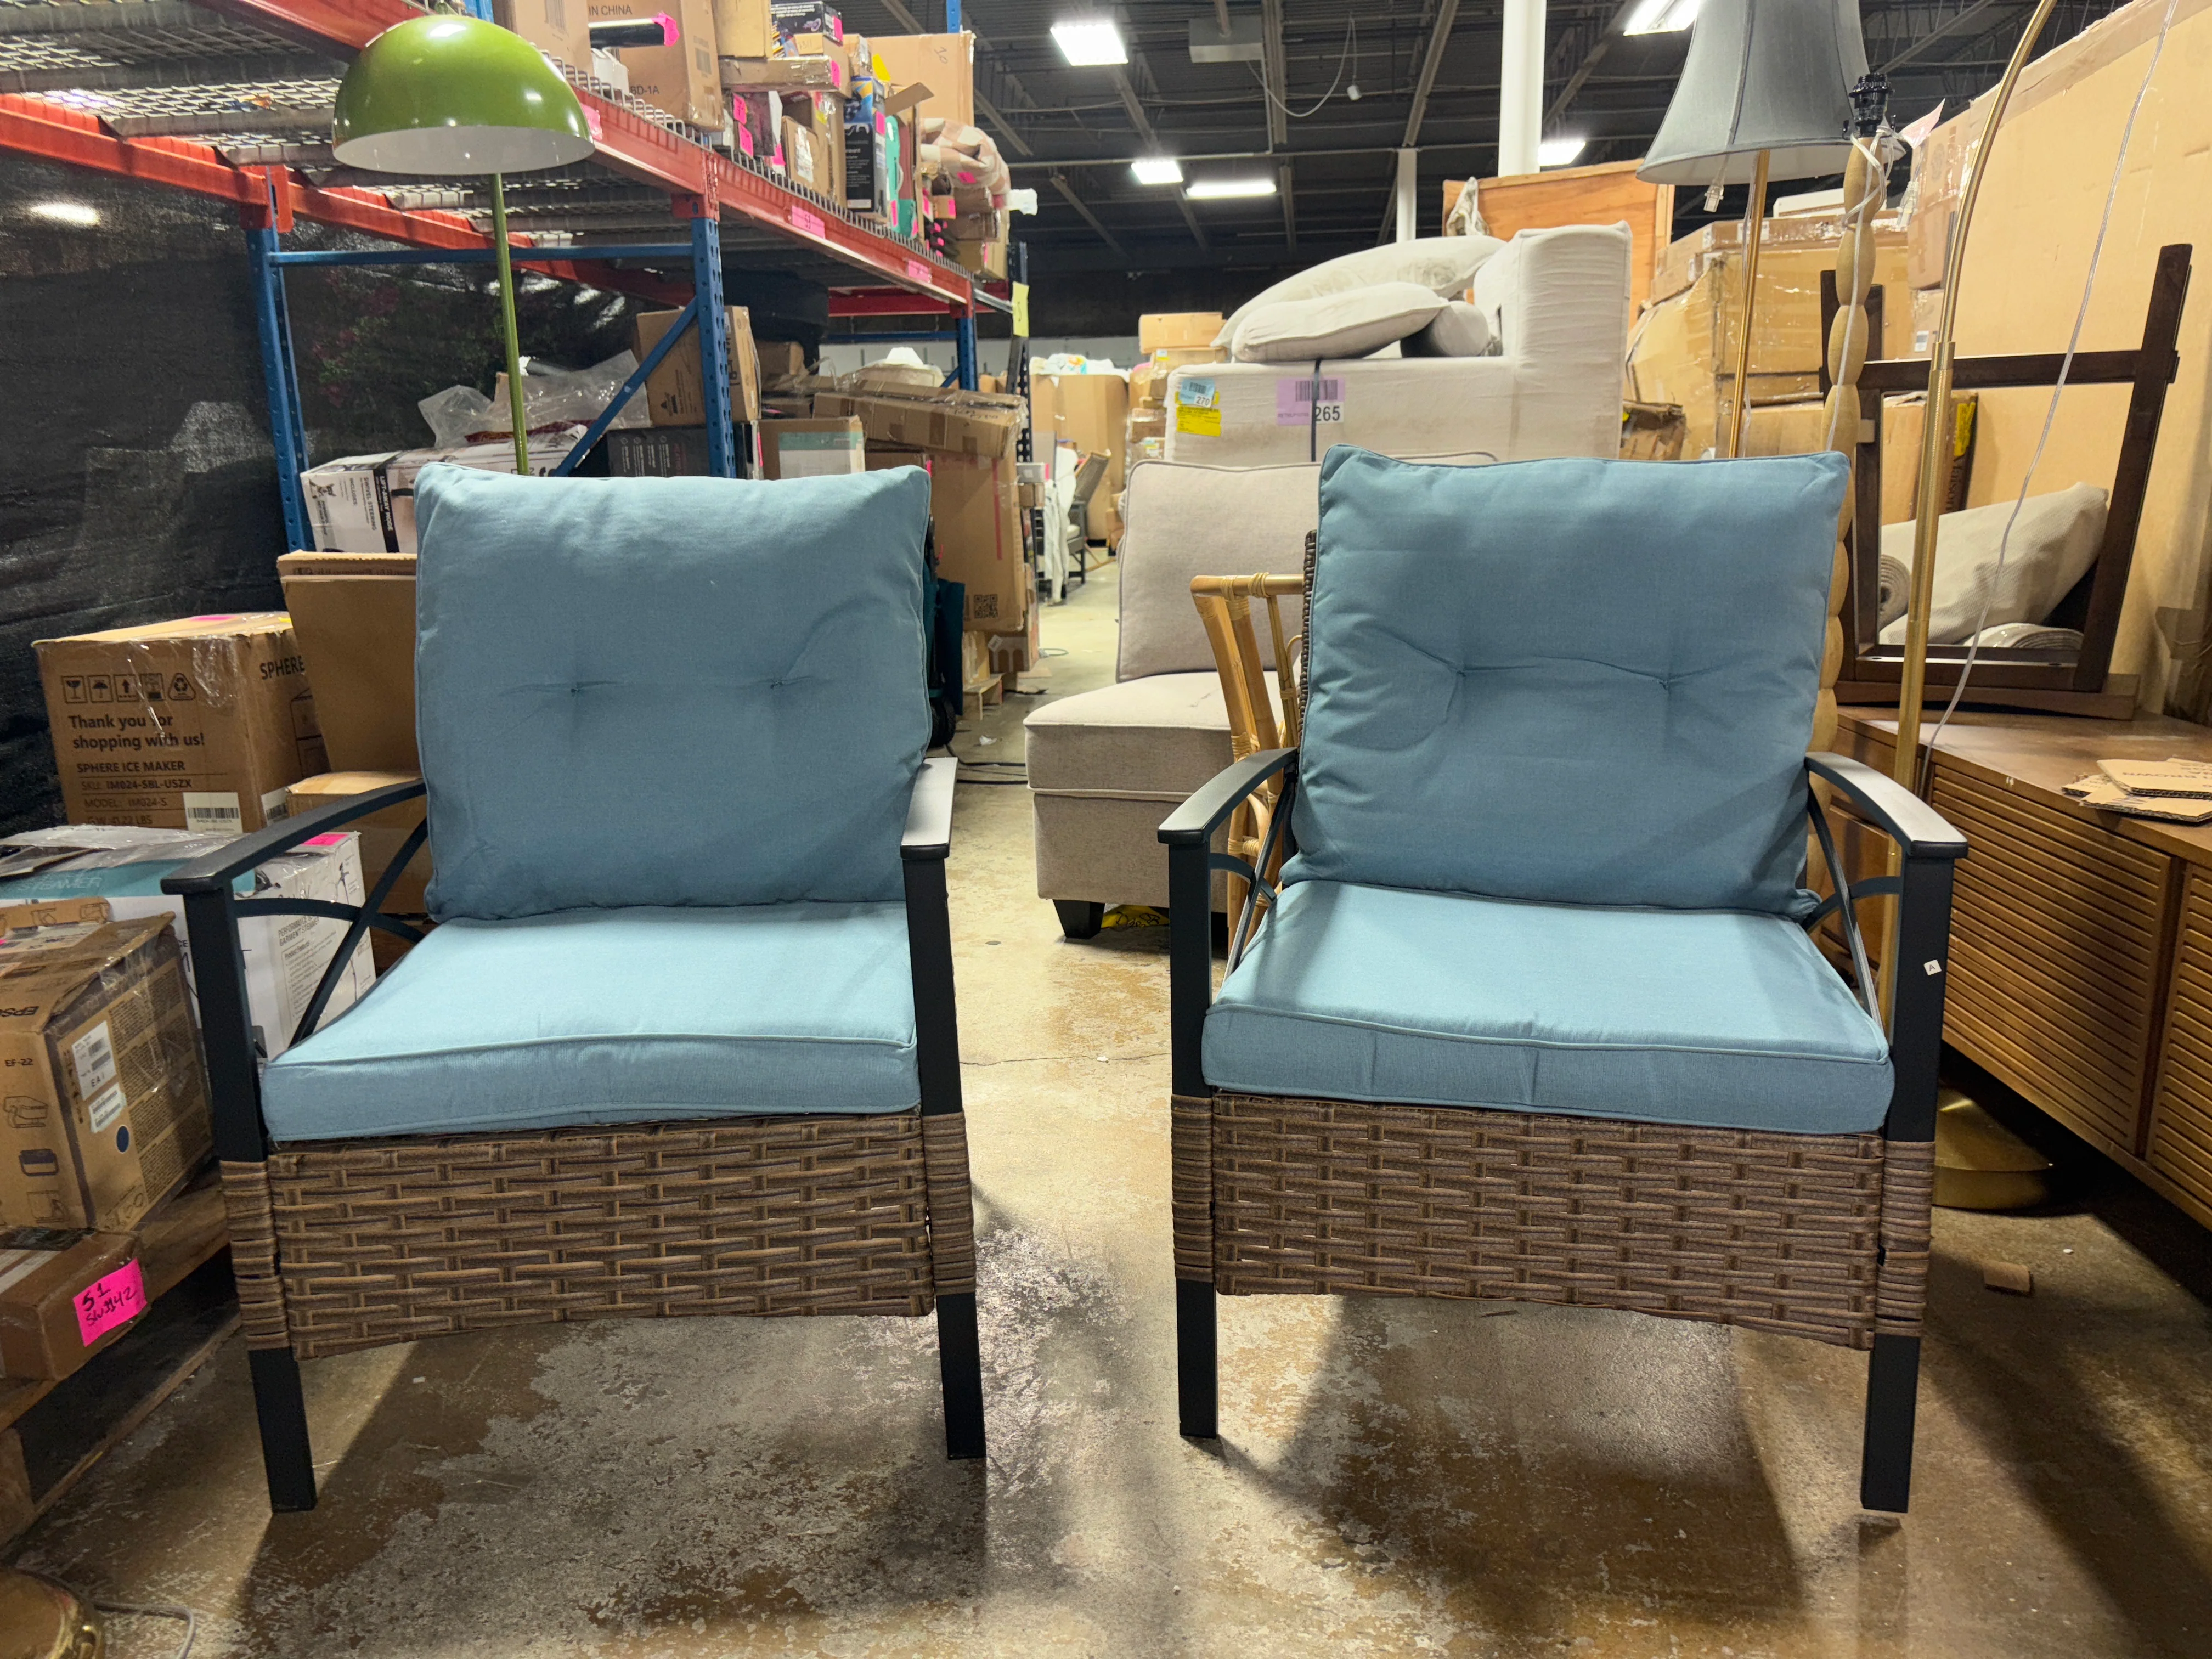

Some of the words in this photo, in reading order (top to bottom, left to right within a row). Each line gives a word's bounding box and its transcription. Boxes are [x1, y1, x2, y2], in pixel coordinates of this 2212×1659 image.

[589, 6, 599, 16] IN
[601, 5, 633, 16] CHINA
[1196, 396, 1210, 406] 270
[1316, 405, 1341, 421] 265
[259, 654, 306, 680] SPHERE
[69, 714, 115, 729] Thank
[118, 716, 146, 731] you
[73, 735, 142, 752] shopping
[145, 733, 179, 747] with
[184, 732, 205, 746] us!
[77, 762, 120, 773] SPHERE
[122, 761, 139, 772] ICE
[143, 761, 186, 771] MAKER
[0, 1006, 40, 1017] EPS
[4, 1058, 33, 1068] EF-22
